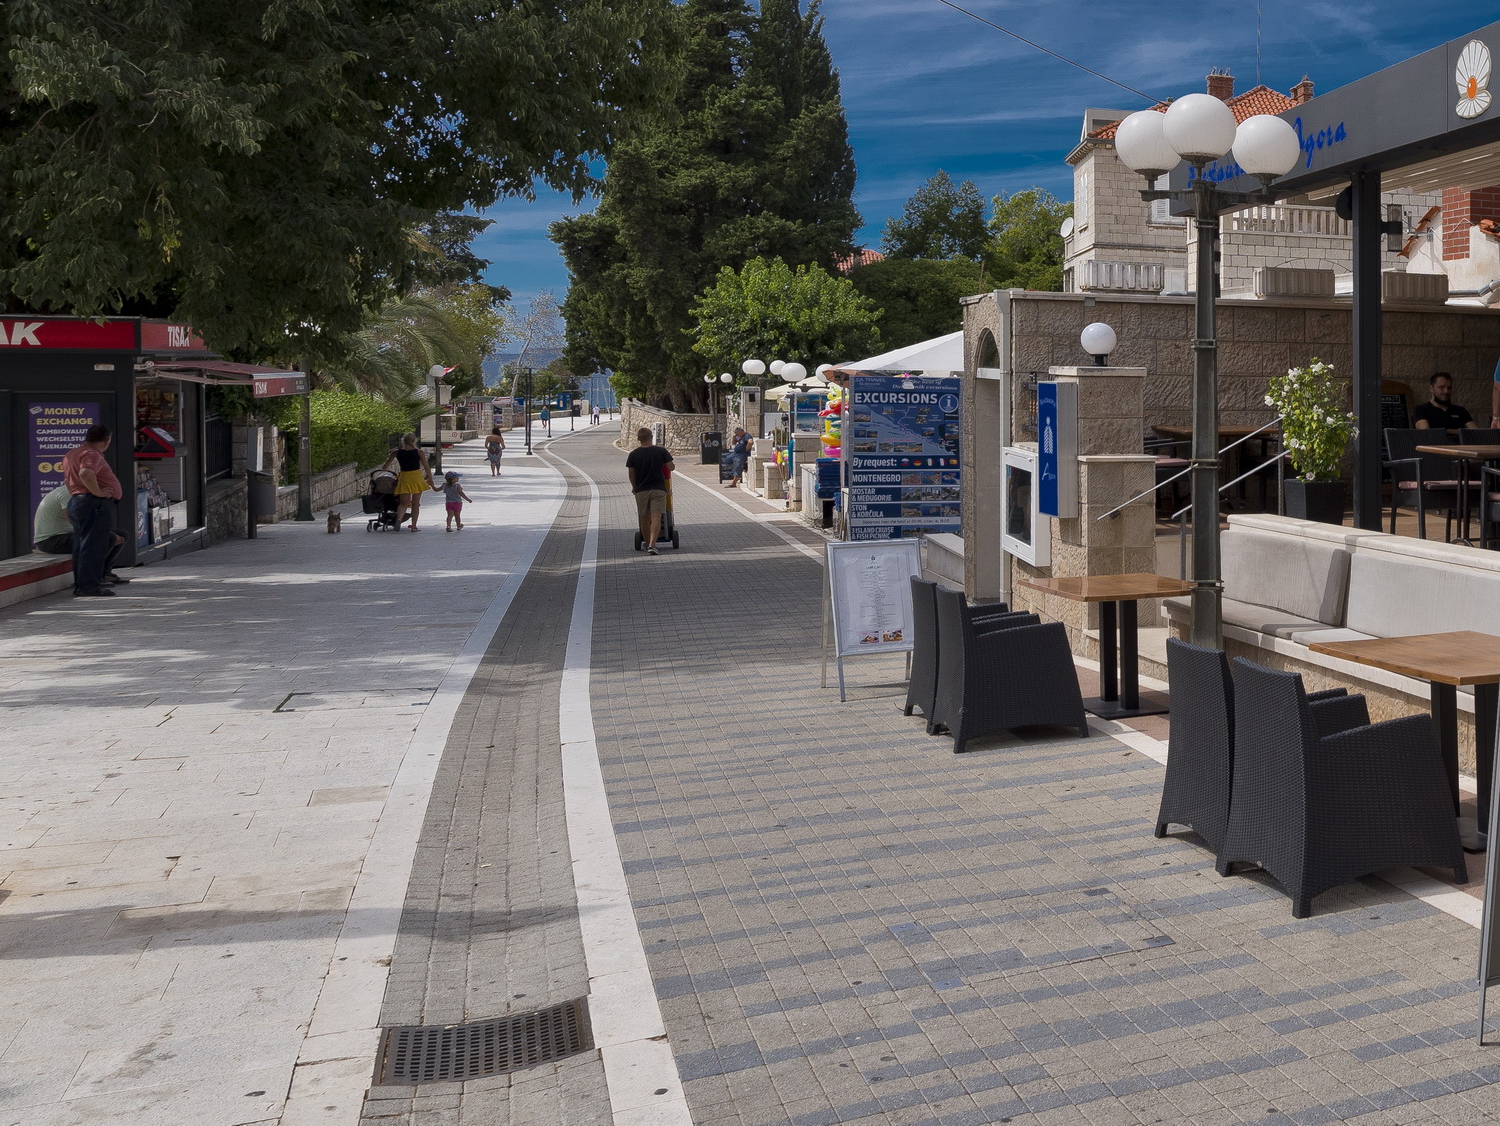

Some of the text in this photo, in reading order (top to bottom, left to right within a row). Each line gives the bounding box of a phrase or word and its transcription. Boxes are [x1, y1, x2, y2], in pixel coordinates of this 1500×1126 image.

[1294, 116, 1347, 169] Agora
[167, 326, 190, 347] TISAK
[854, 392, 938, 404] EXCURSIONS
[853, 457, 897, 468] By request:
[852, 474, 901, 482] MONTENEGRO
